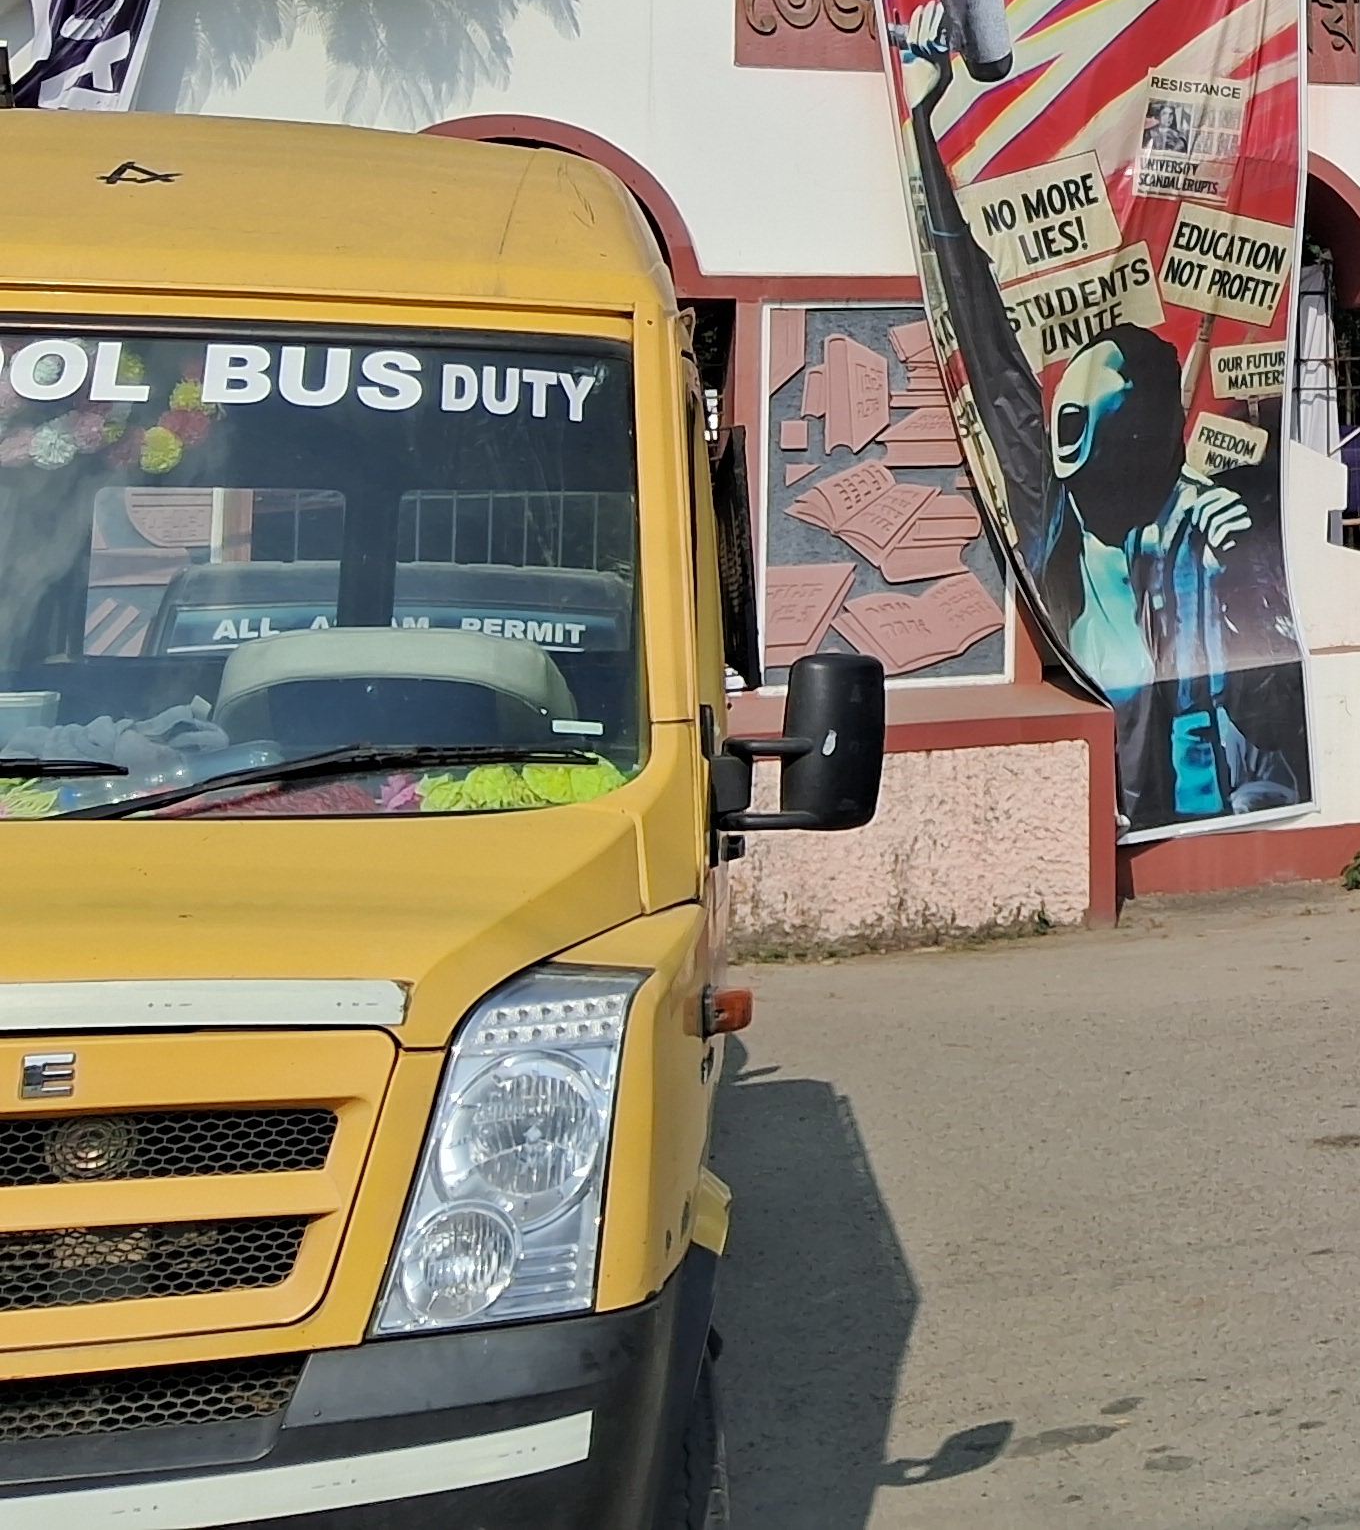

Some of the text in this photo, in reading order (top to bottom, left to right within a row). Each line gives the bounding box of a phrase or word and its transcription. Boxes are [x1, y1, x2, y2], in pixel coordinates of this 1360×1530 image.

[1150, 76, 1242, 100] RESISTANCE
[981, 172, 1099, 236] NO MORE
[1017, 216, 1089, 265] LIES!
[1172, 221, 1288, 275] EDUCATION
[1005, 257, 1151, 334] STUDENTS
[1163, 255, 1281, 311] NOT PROFIT!
[201, 343, 424, 412] BUS
[440, 362, 596, 423] DUTY
[1217, 350, 1286, 373] OUR FUTUR
[1197, 425, 1258, 460] FREEDOM
[212, 617, 281, 641] ALL
[461, 617, 587, 645] PERMIT
